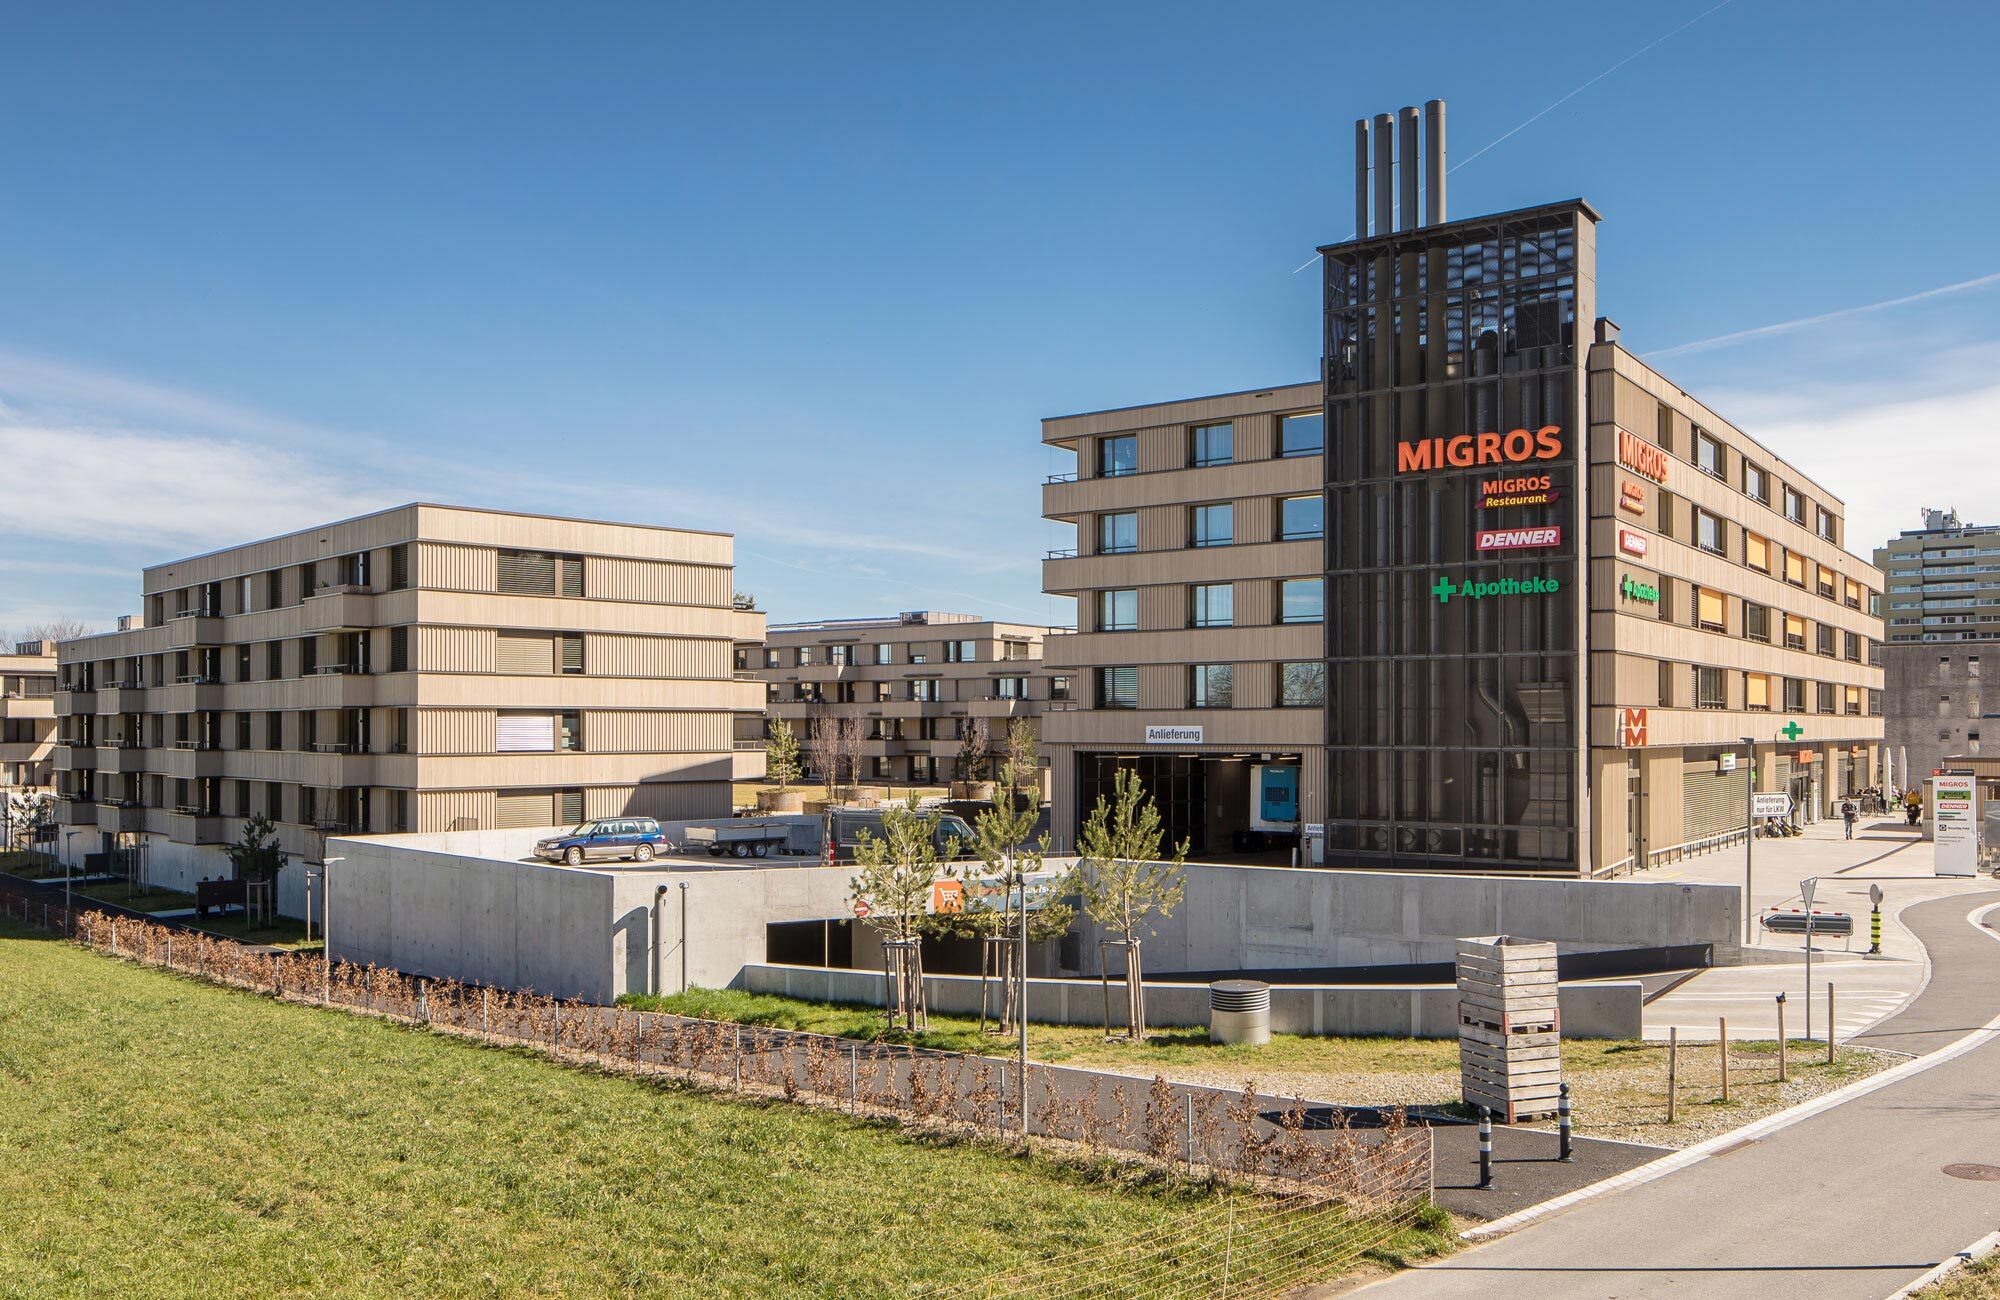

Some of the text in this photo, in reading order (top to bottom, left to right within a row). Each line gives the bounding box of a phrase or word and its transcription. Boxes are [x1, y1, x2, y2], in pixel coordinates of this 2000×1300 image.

[1398, 425, 1562, 472] MIGROS
[1620, 431, 1668, 482] MIGROS
[1483, 476, 1550, 494] MIGROS
[1486, 494, 1547, 507] Restaurant
[1480, 530, 1556, 547] DENNER
[1461, 577, 1559, 599] Apotheke
[1149, 729, 1200, 741] Anlieferung
